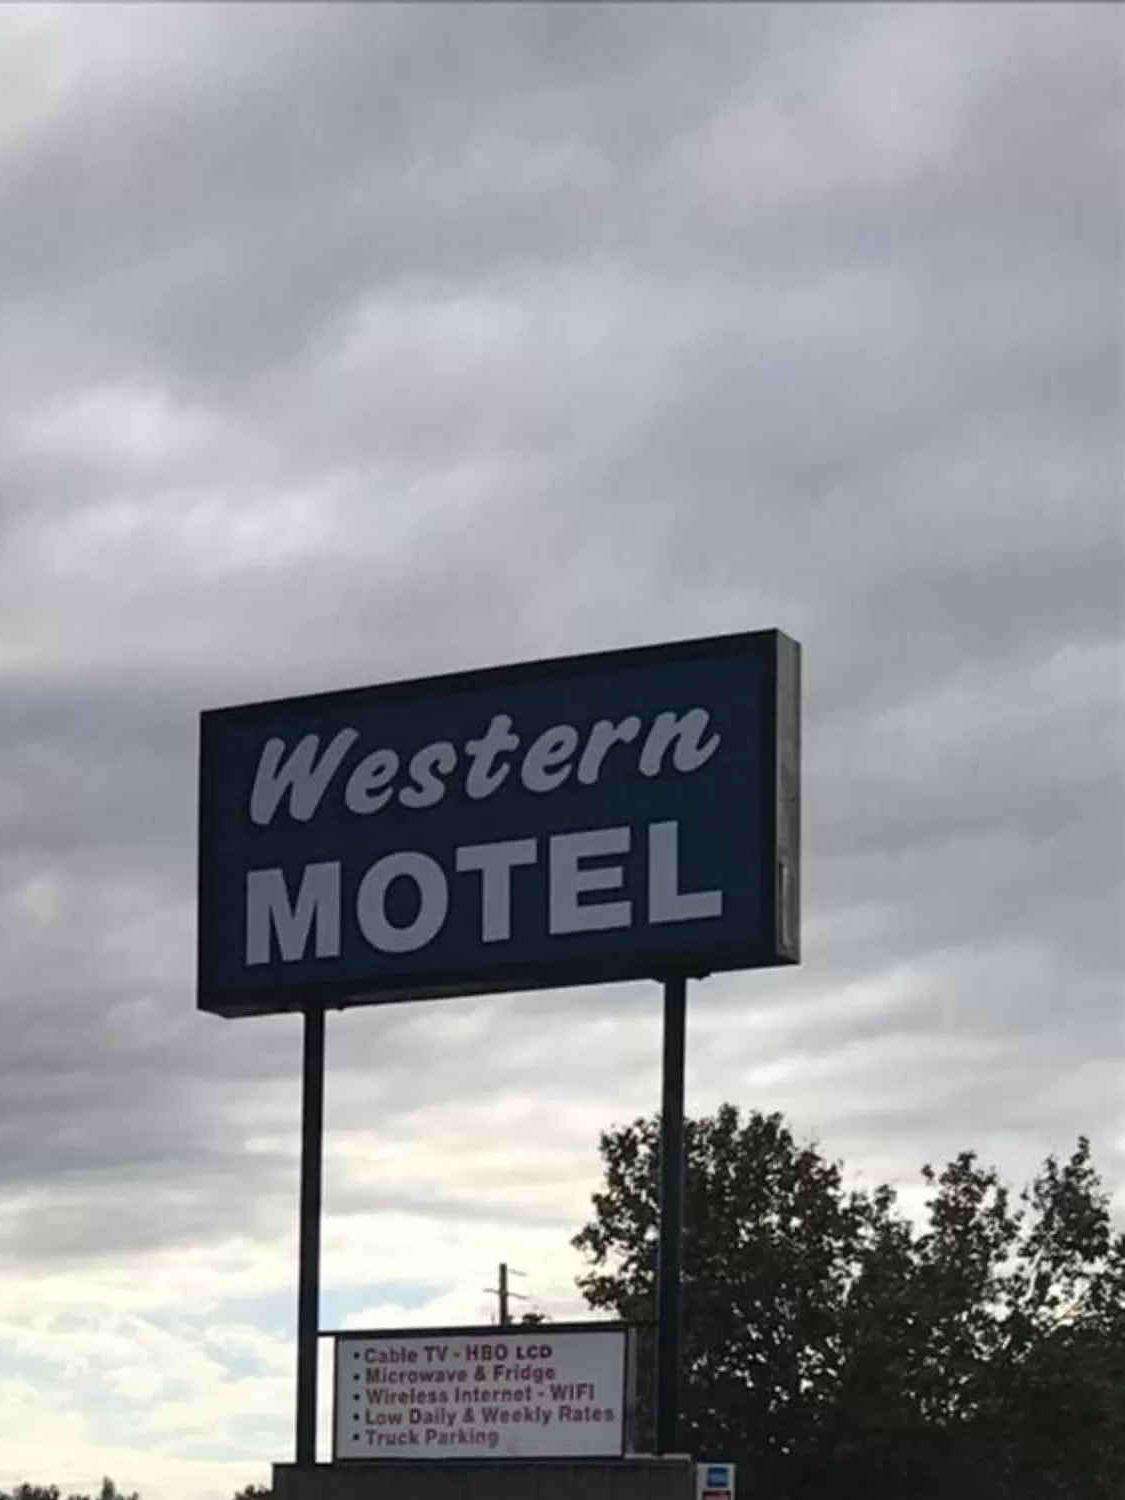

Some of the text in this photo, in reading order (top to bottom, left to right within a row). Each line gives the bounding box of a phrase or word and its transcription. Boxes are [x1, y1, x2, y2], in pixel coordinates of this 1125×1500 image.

[249, 705, 721, 826] Western
[245, 820, 723, 965] MOTEL
[364, 1347, 418, 1365] Cable
[424, 1346, 448, 1363] TV
[465, 1344, 508, 1362] HBO
[516, 1344, 552, 1361] LCD
[365, 1363, 556, 1385] Microwave & Fridge
[365, 1387, 448, 1406] Wireless
[455, 1384, 532, 1404] Internet
[549, 1383, 596, 1401] WIFI
[365, 1405, 615, 1427] Low Daily & Weekly Rates
[365, 1428, 499, 1448] Truck Parking
